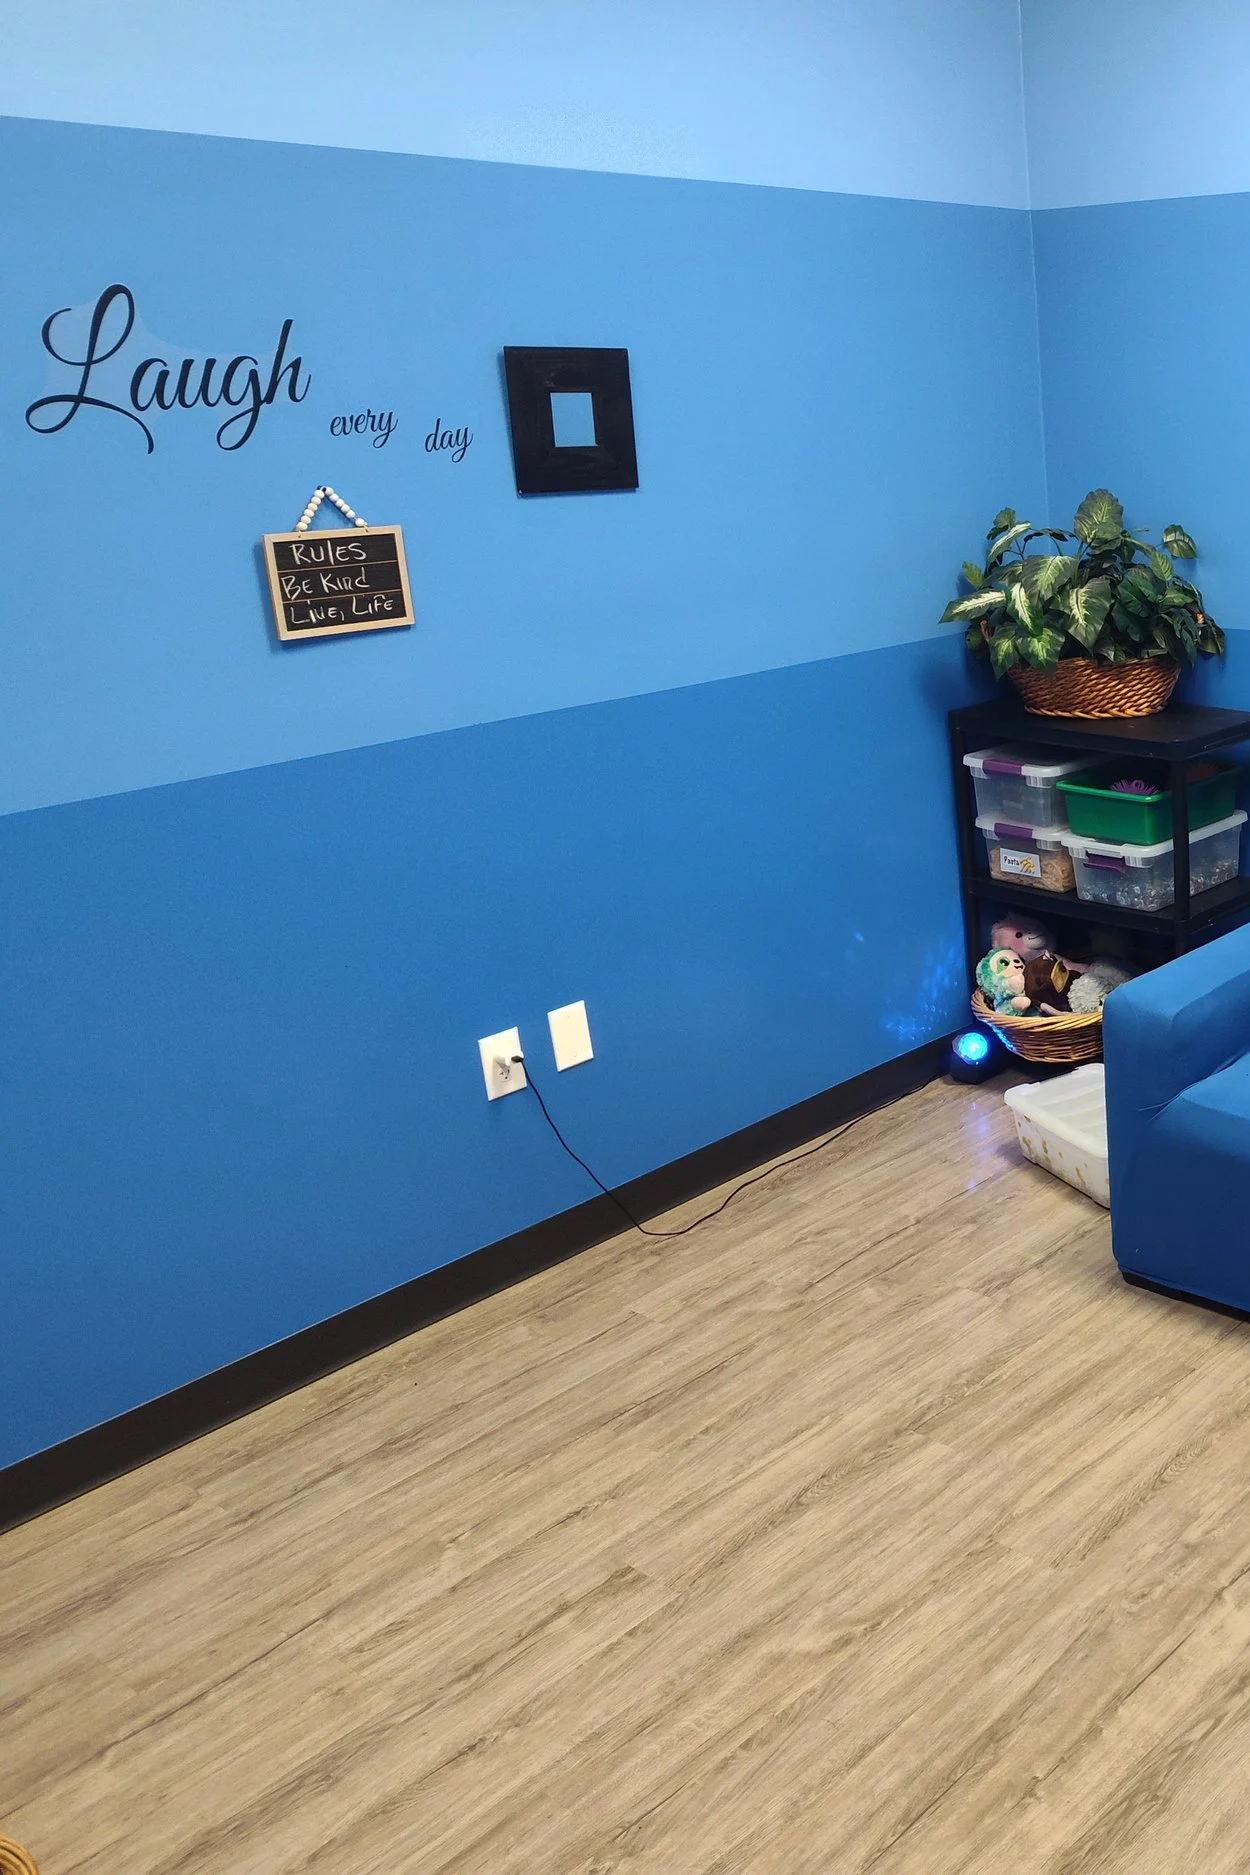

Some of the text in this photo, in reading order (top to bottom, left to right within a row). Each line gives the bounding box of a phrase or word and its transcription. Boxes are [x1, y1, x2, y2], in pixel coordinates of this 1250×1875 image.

[25, 283, 473, 463] Laugh every day
[1003, 855, 1020, 866] Pasta
